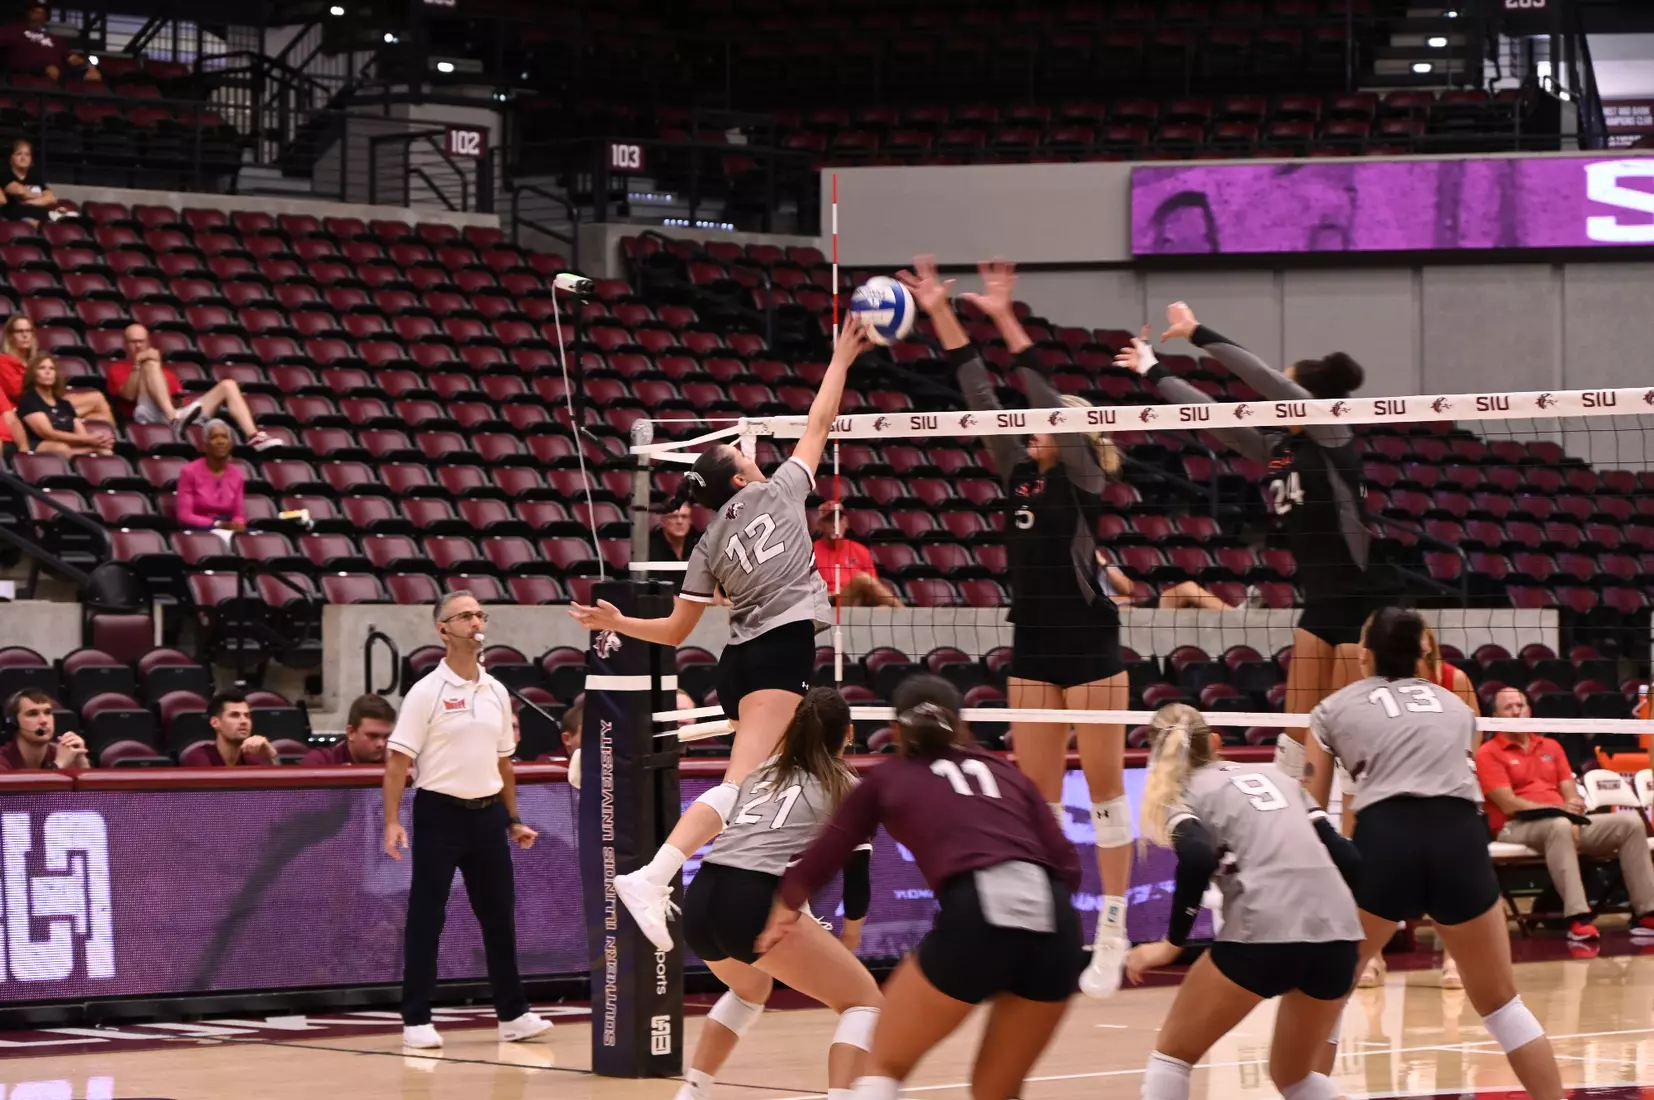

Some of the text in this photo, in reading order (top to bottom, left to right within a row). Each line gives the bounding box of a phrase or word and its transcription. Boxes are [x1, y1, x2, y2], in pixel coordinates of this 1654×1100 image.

[450, 129, 480, 155] 102
[611, 143, 642, 169] 103
[910, 415, 938, 430] SIU
[996, 413, 1026, 428] SIU
[1087, 409, 1116, 425] SIU
[1179, 406, 1210, 422] SIU
[1275, 402, 1307, 419] SIU
[1373, 399, 1406, 416] SIU
[1475, 395, 1510, 412] SIU
[1581, 391, 1617, 408] SIU
[1269, 471, 1306, 515] 24
[724, 511, 786, 575] 12
[1367, 684, 1445, 719] 13
[929, 758, 1003, 799] 11
[1230, 771, 1290, 812] 9
[734, 780, 803, 830] 21
[601, 719, 617, 1047] SOUTHERN ILLINOIS UNIVERSITY
[654, 948, 668, 995] ports
